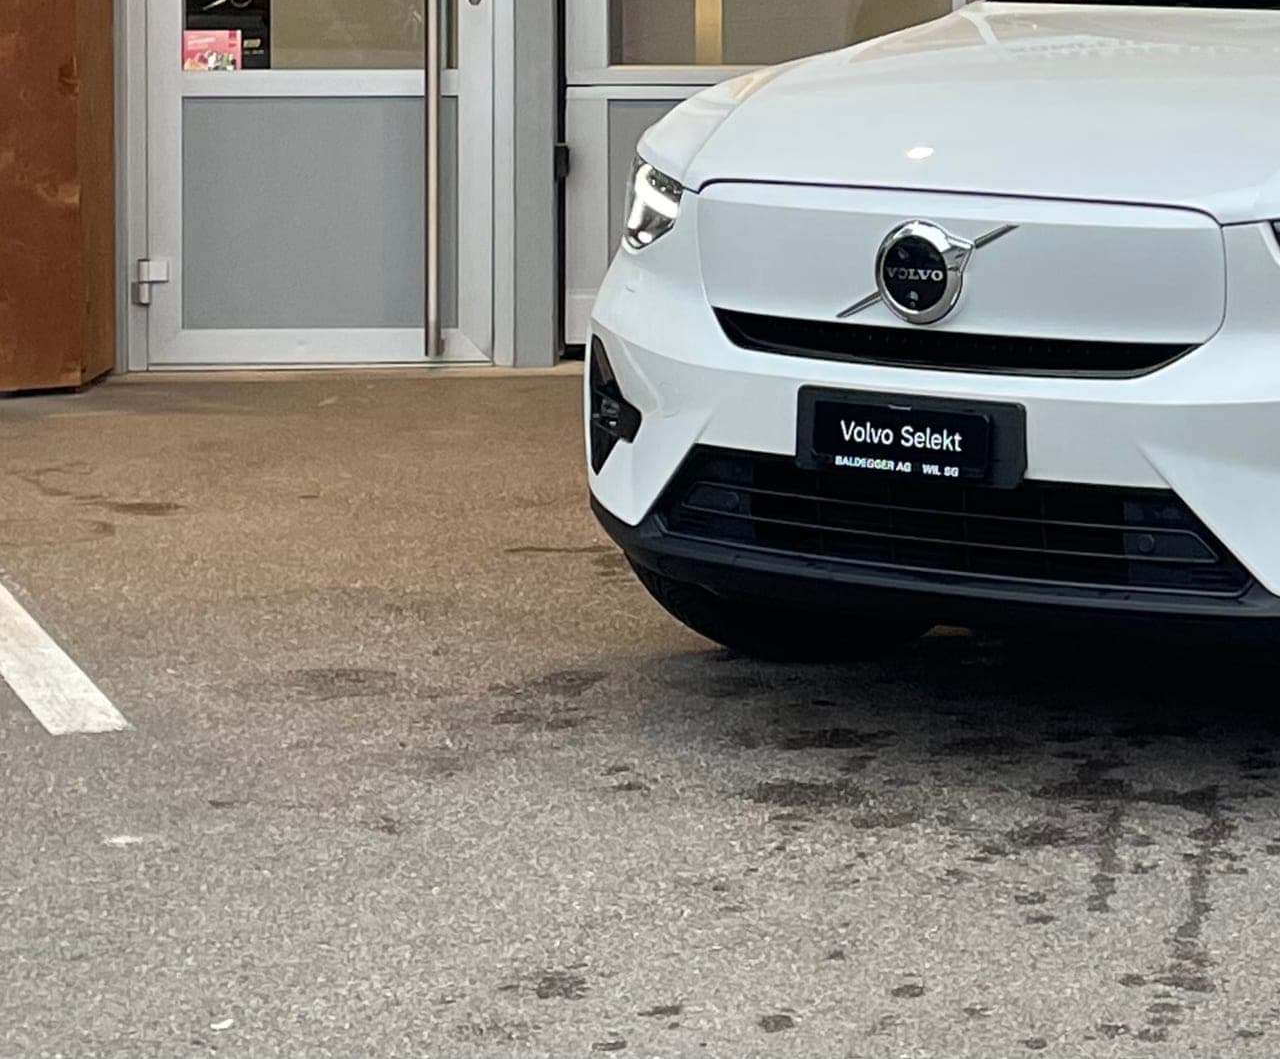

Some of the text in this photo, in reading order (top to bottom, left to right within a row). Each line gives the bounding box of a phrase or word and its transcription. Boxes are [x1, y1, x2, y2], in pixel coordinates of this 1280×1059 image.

[886, 267, 944, 282] VOLVO
[840, 419, 963, 452] Volvo Selekt
[835, 455, 959, 477] BALDEGGER AG WIL SG
